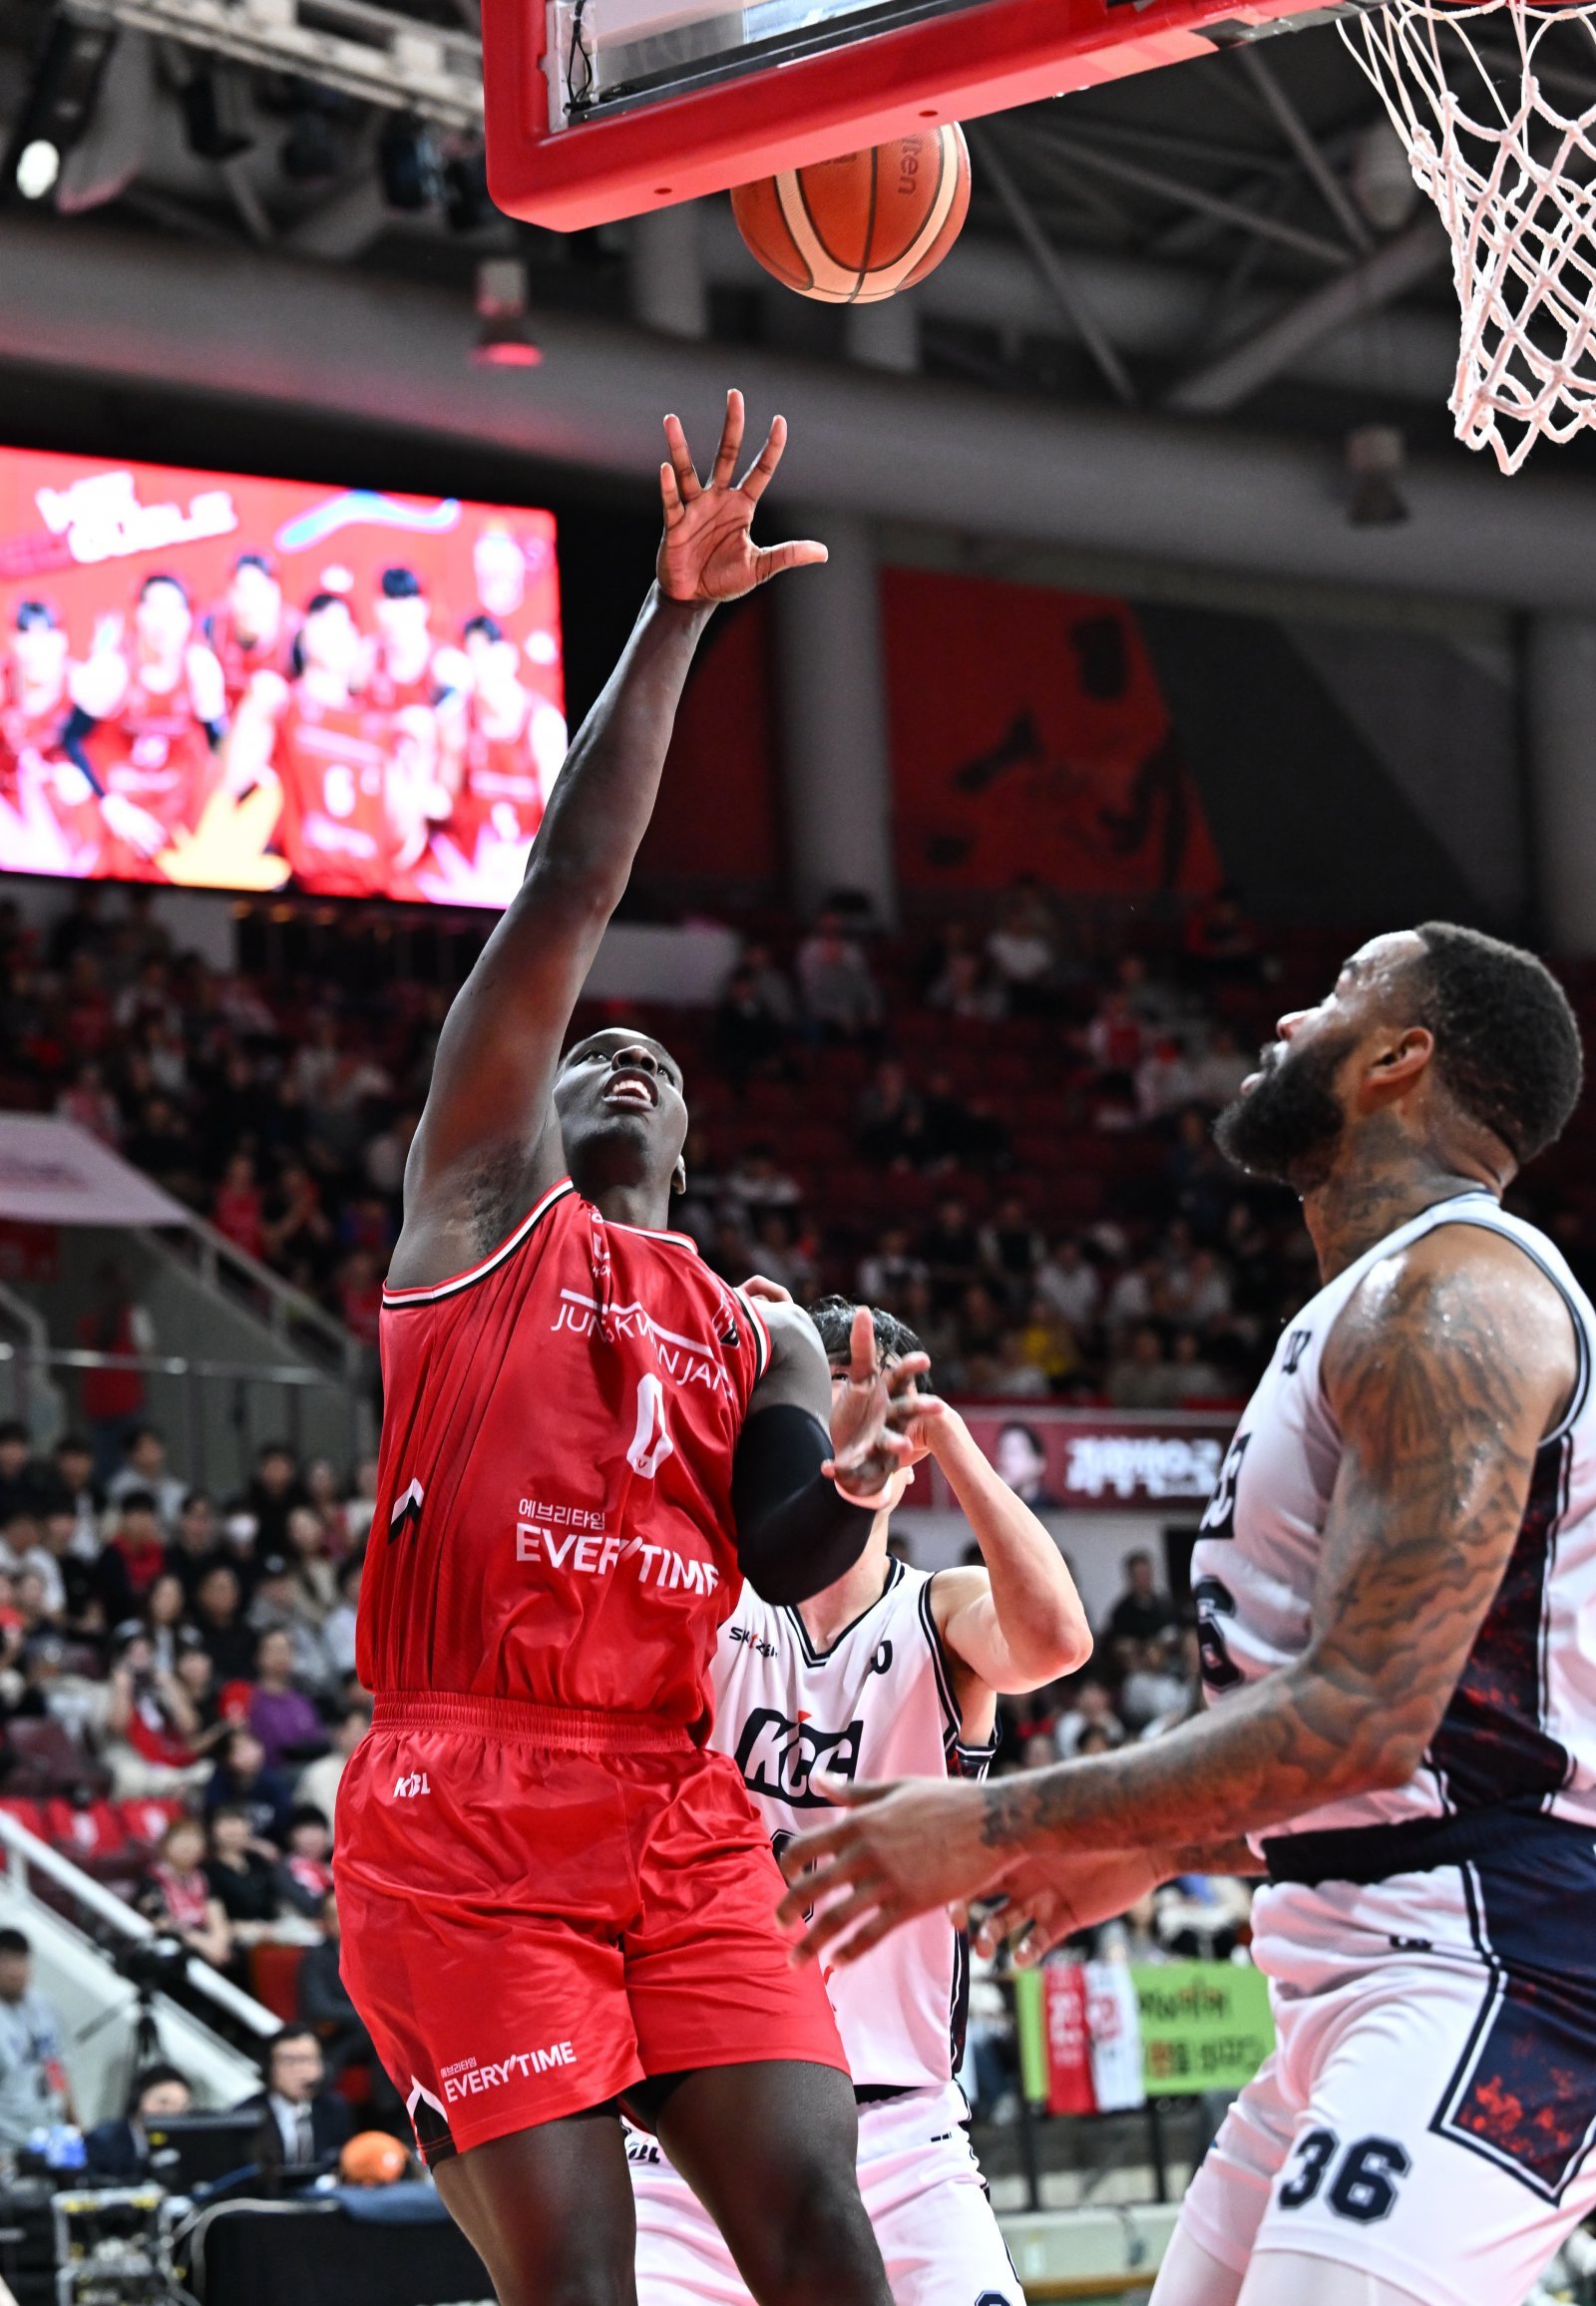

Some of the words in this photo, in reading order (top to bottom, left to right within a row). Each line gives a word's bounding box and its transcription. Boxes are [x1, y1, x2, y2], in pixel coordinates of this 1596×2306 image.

[626, 1372, 674, 1479] 0
[519, 1498, 605, 1531] 에브리타임
[392, 1770, 431, 1798] KBL
[742, 1719, 854, 1799] KCC
[1278, 2126, 1412, 2226] 36
